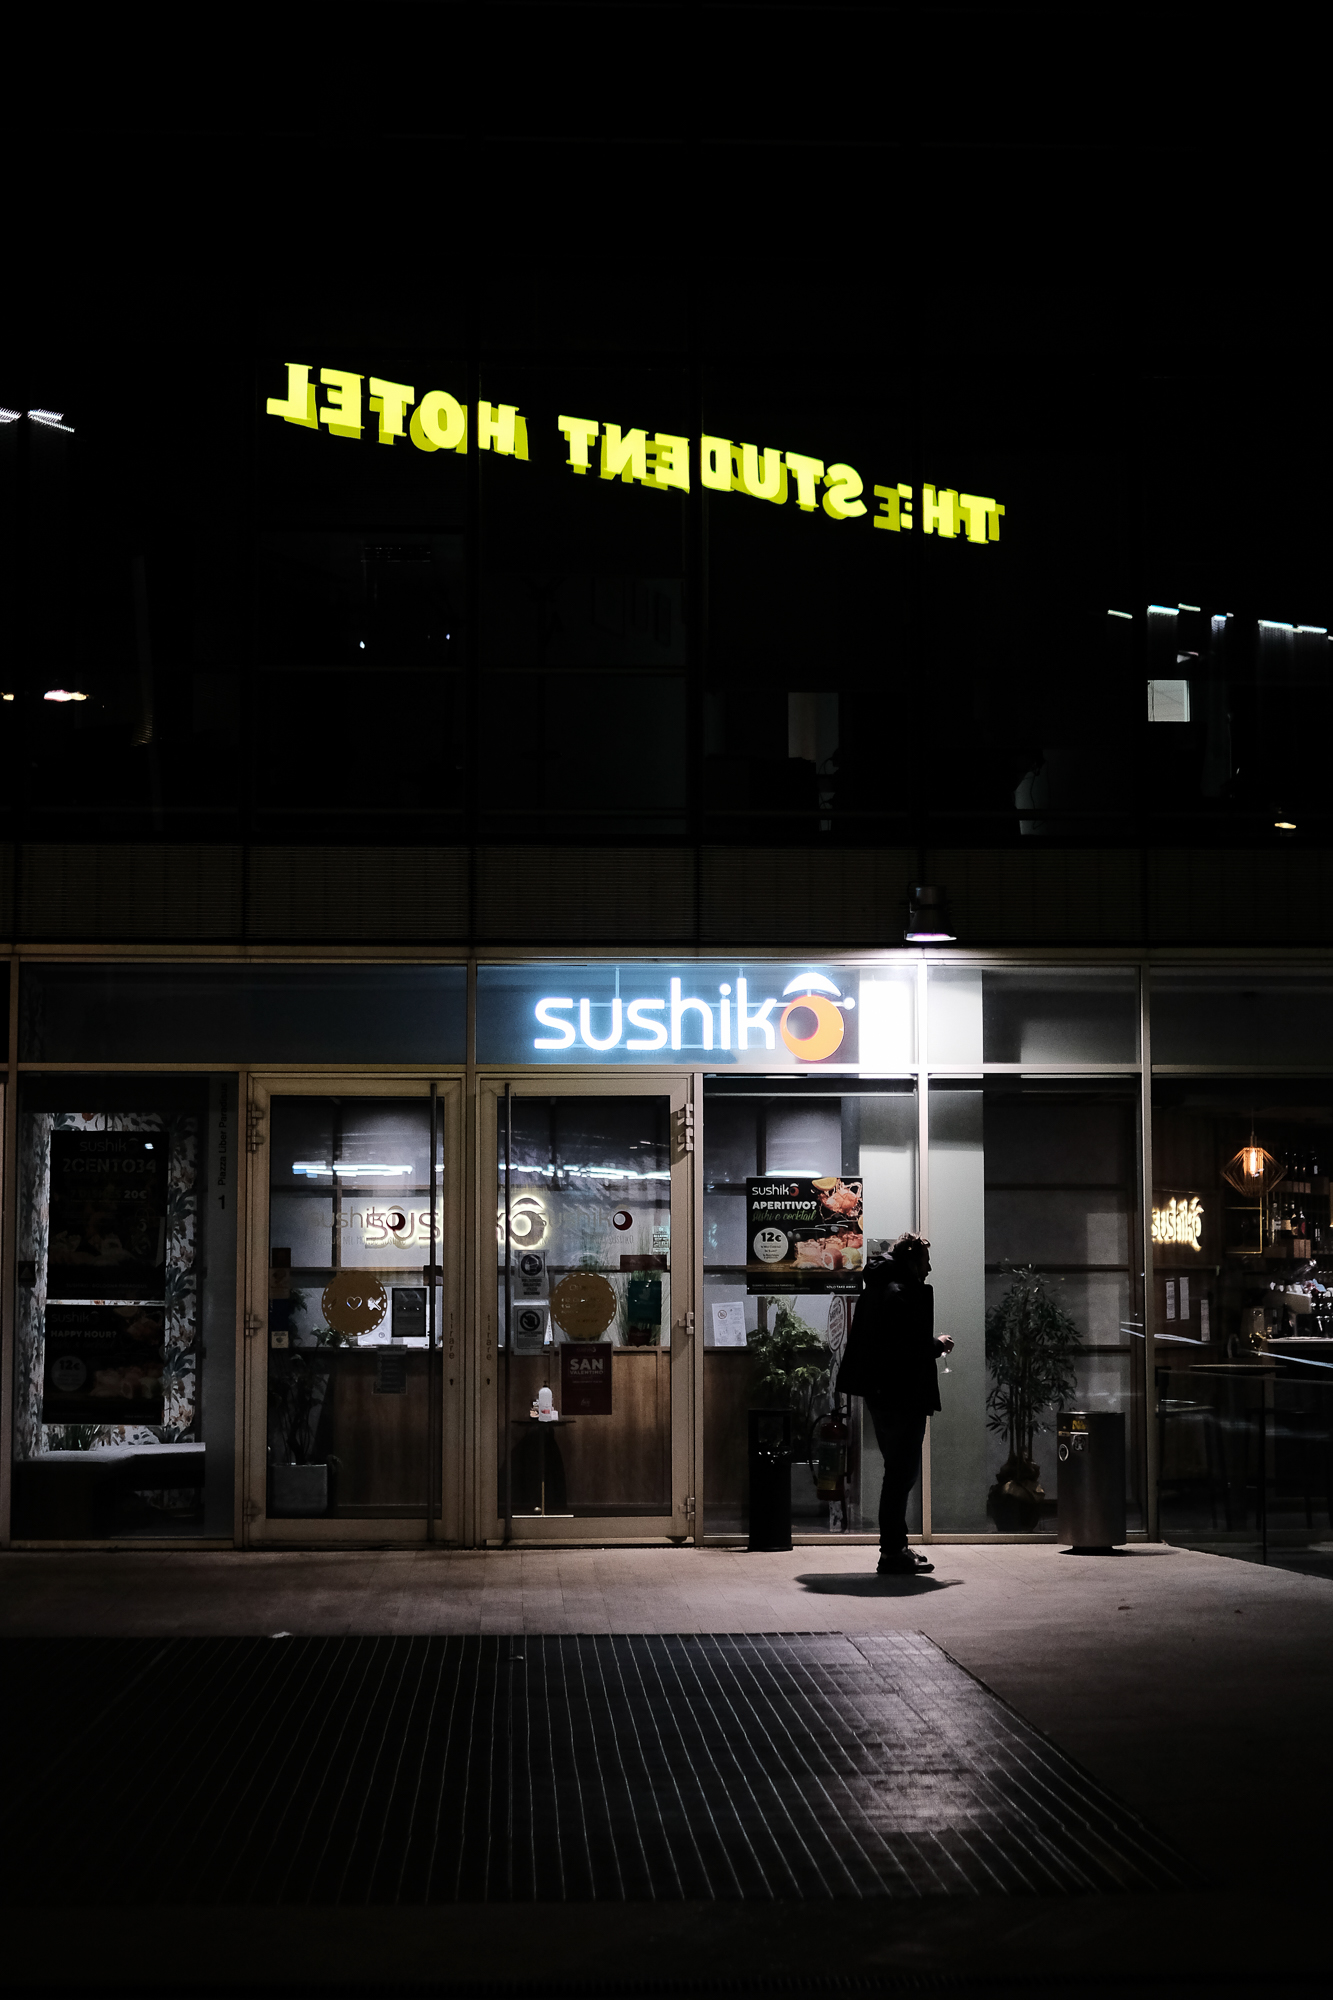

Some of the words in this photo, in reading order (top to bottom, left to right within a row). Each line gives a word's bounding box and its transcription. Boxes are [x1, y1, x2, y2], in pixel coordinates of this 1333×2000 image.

[219, 1083, 228, 1128] Paradisus
[218, 1130, 227, 1154] Liber
[218, 1156, 226, 1186] Piazza
[124, 1189, 148, 1200] 20€
[752, 1200, 818, 1211] APERITIVO?
[761, 1232, 782, 1243] 12€
[50, 1330, 82, 1338] HAPPY
[84, 1331, 117, 1339] HOUR?
[570, 1358, 604, 1370] SAN
